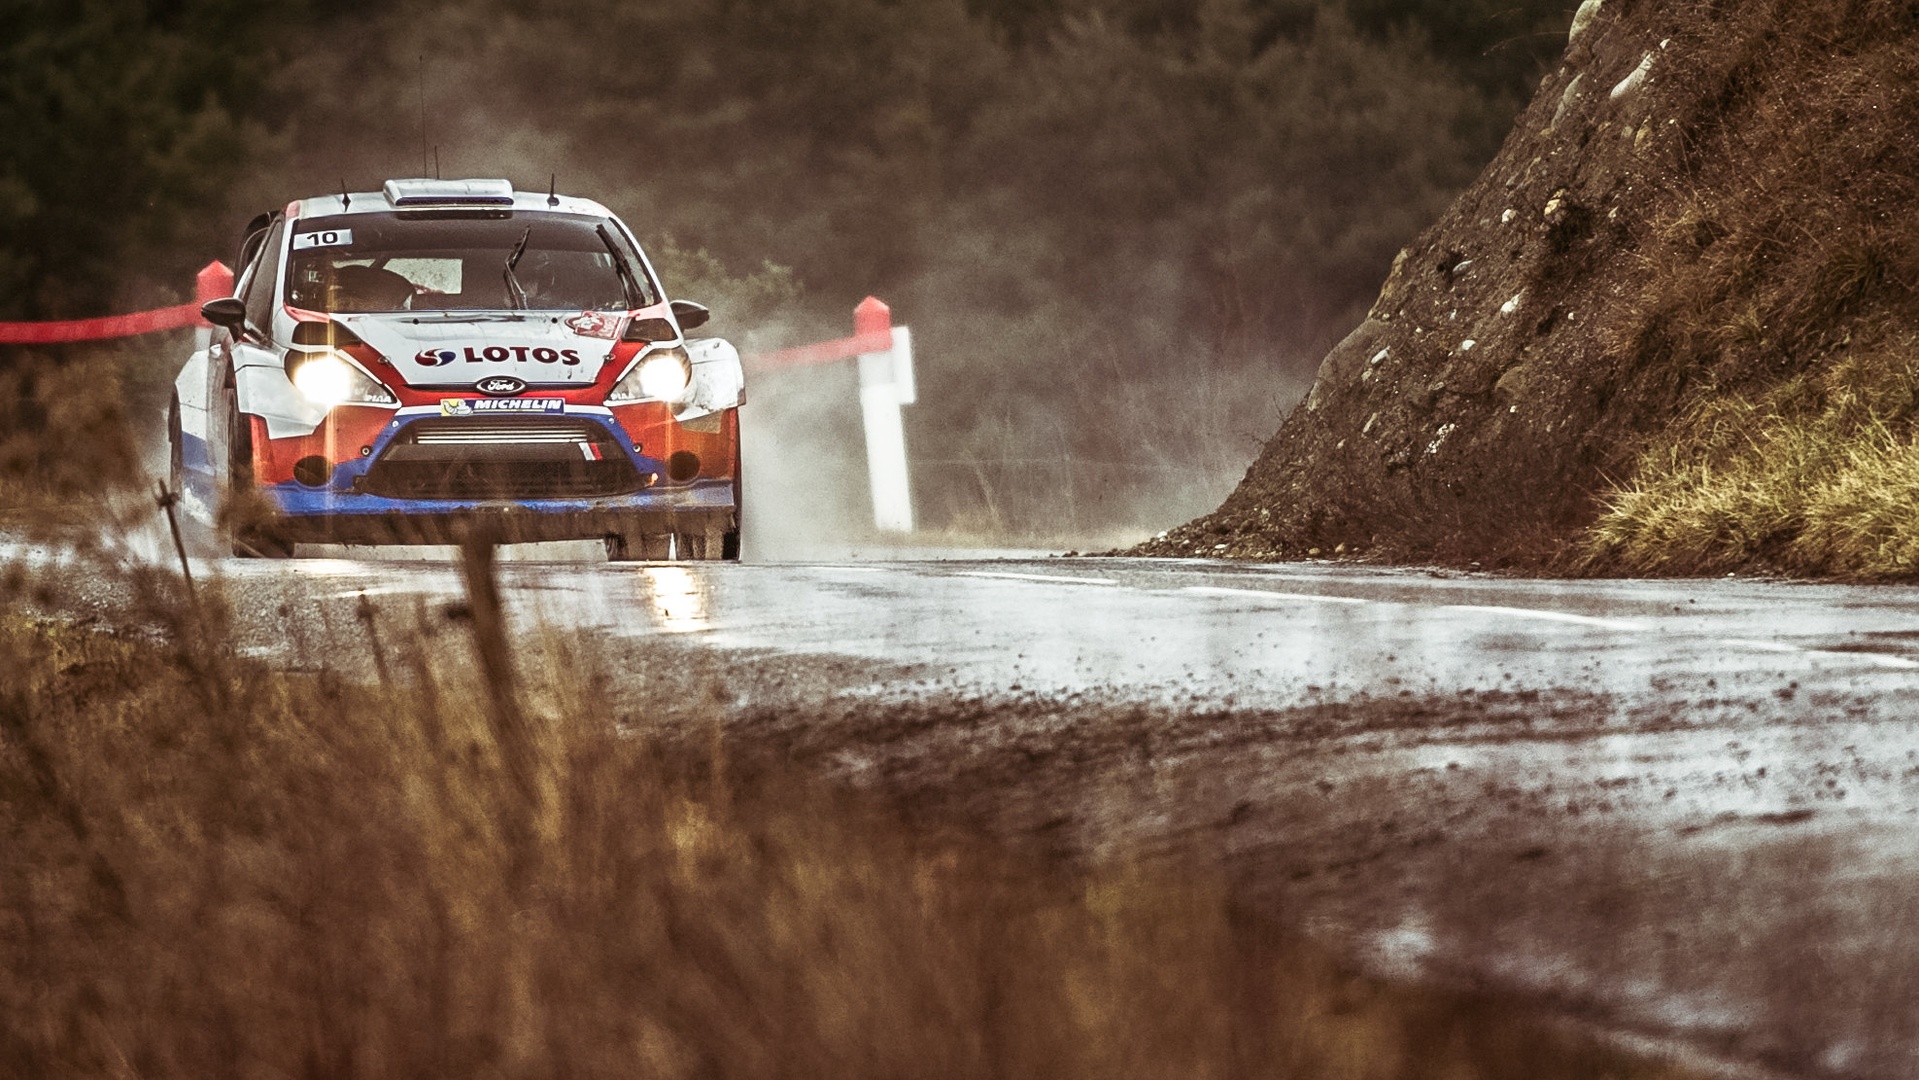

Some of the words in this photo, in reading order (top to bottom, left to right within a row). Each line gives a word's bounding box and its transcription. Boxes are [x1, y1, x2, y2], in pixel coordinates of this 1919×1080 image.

[306, 231, 338, 246] 10
[463, 346, 581, 366] LOTOS
[487, 380, 515, 391] Ford
[473, 399, 562, 410] MICHELIN
